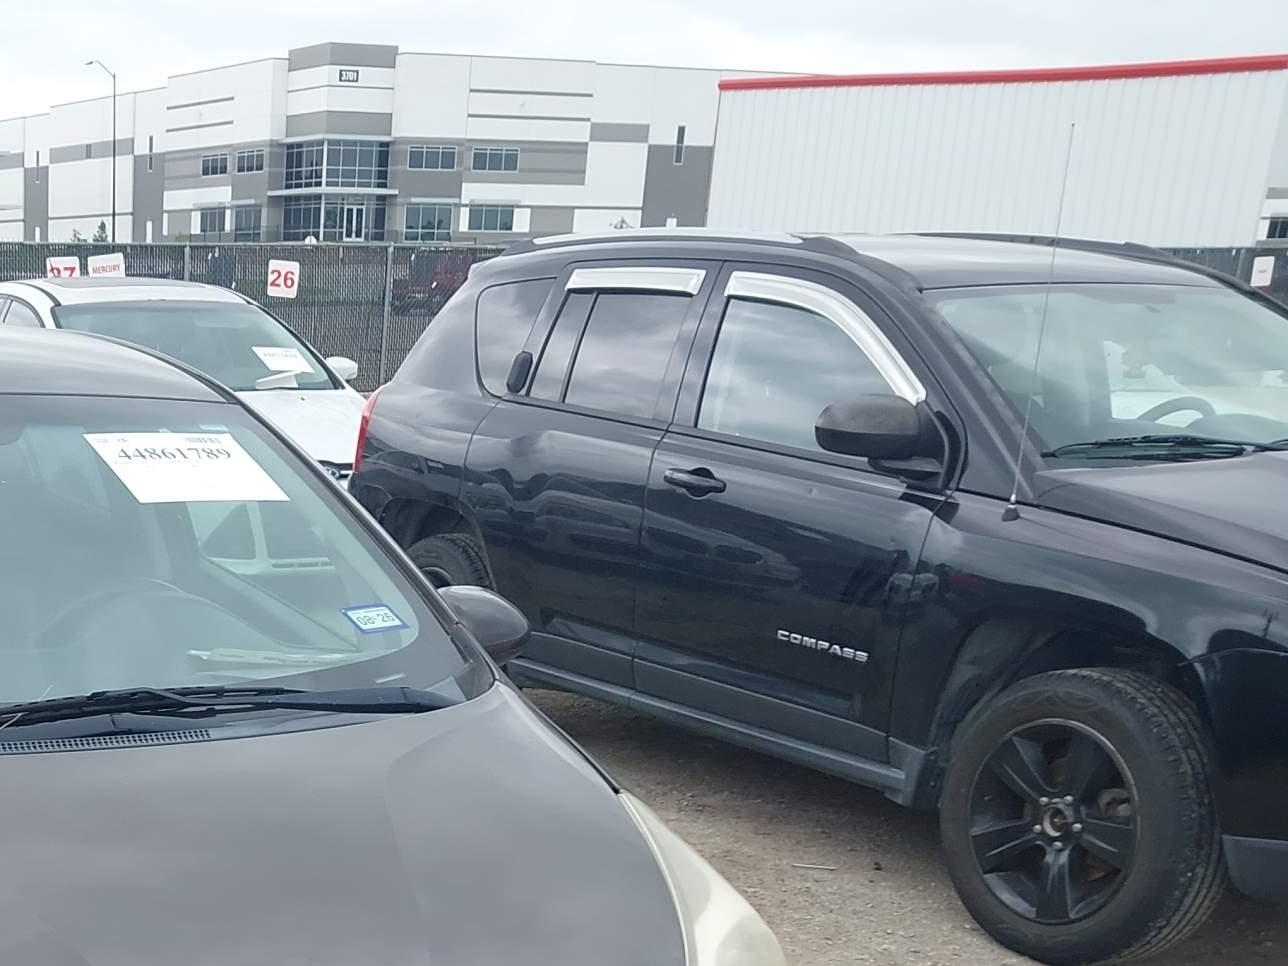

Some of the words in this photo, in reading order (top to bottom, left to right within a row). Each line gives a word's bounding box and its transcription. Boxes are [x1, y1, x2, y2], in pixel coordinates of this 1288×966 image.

[341, 71, 357, 81] 3701
[92, 264, 121, 274] MERCURY
[269, 269, 295, 289] 26
[117, 447, 232, 460] 44861789
[776, 629, 869, 663] COMPASS
